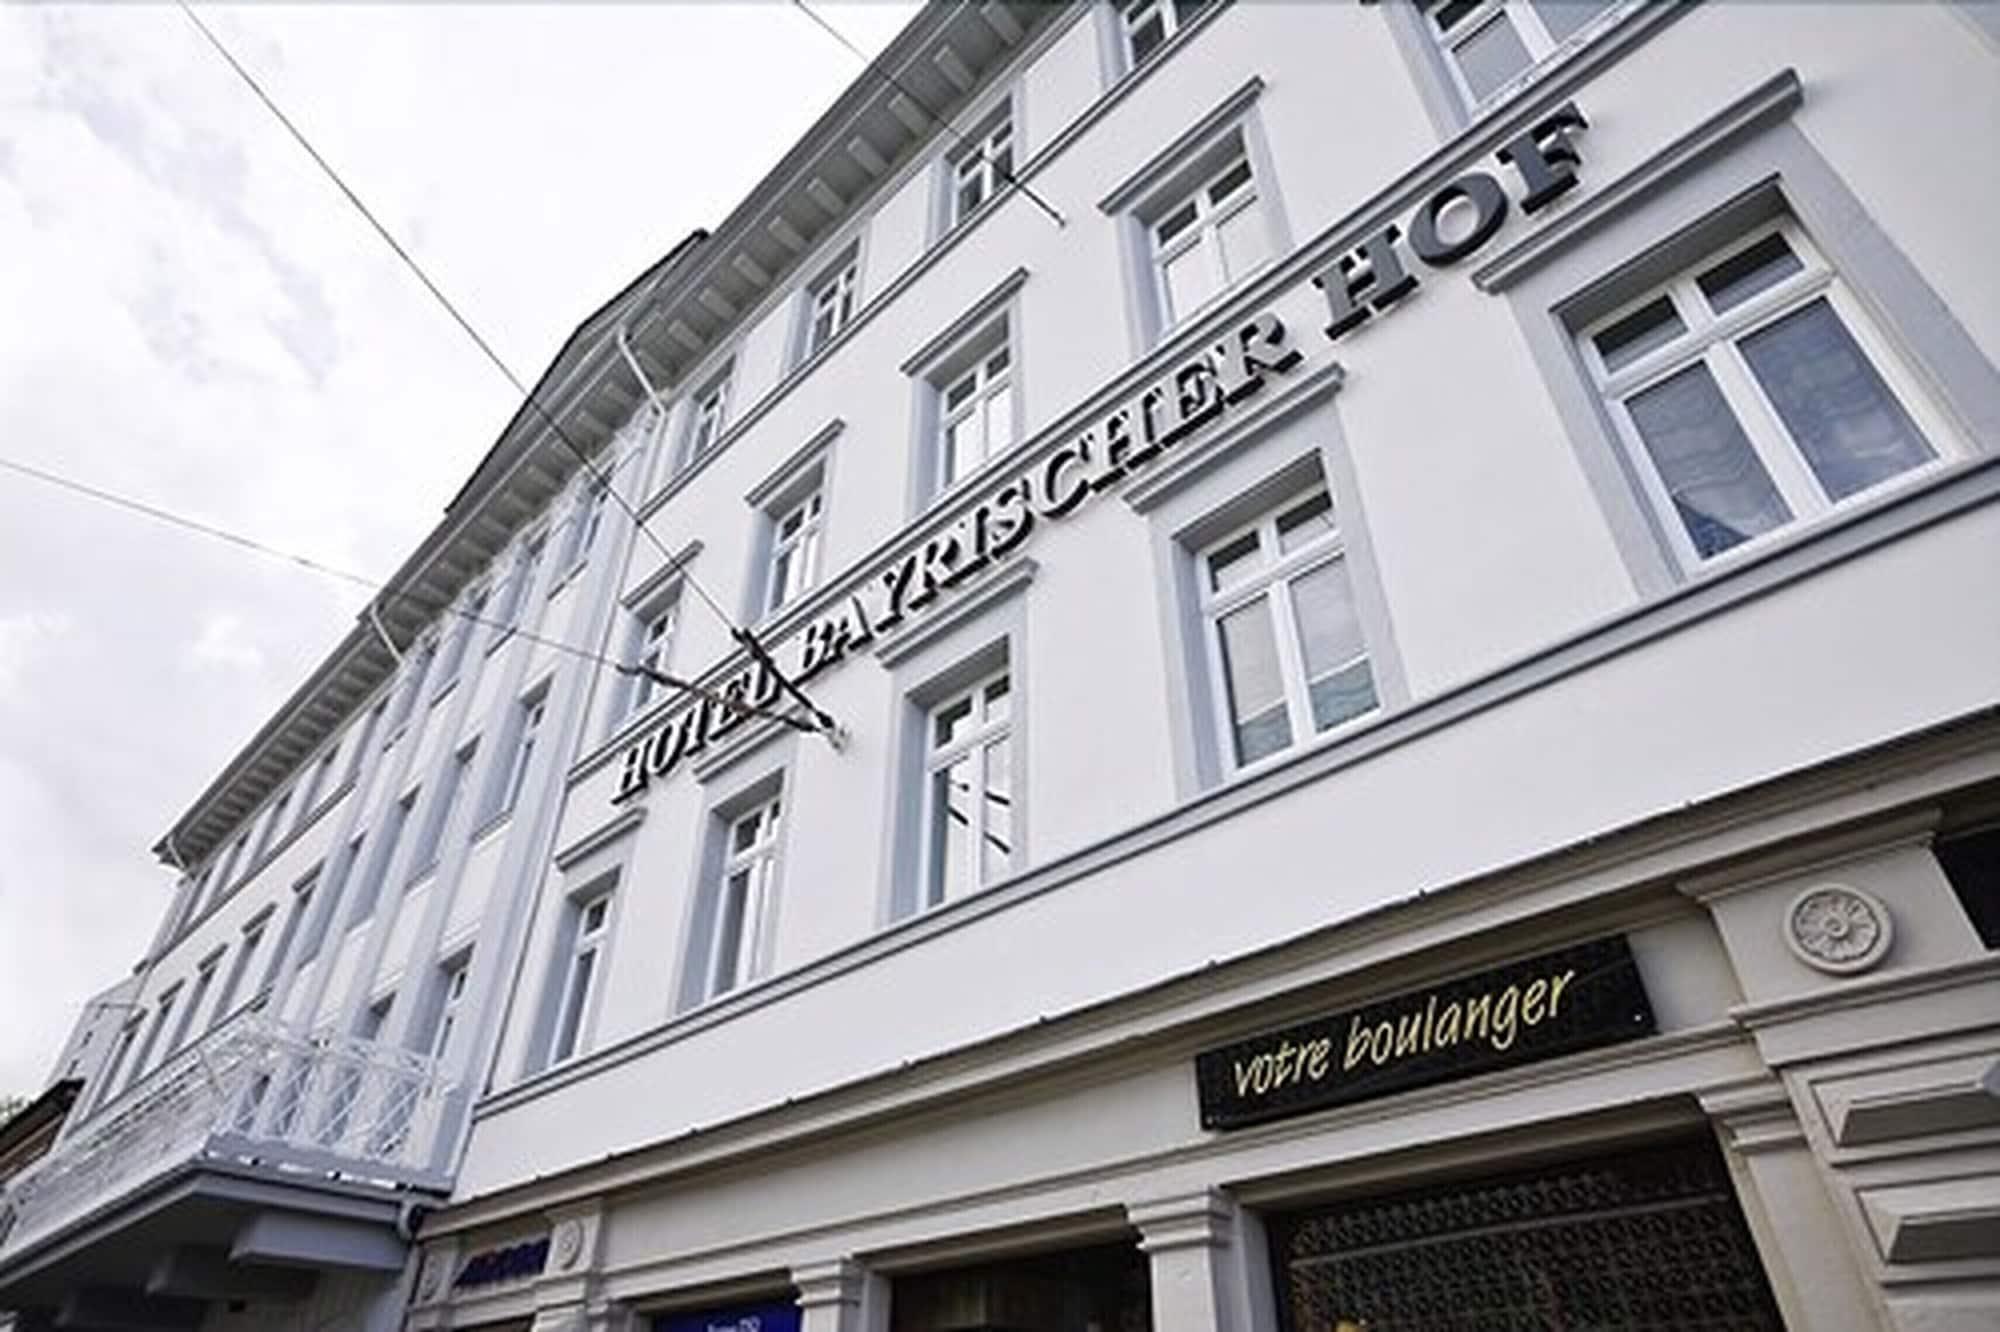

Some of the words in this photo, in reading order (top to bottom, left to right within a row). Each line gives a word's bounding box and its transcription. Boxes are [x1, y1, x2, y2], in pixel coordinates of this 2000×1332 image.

[791, 312, 1303, 687] BAYRISCHER
[1312, 100, 1589, 340] HOF
[1233, 1035, 1331, 1096] votre
[1343, 969, 1575, 1050] boulanger
